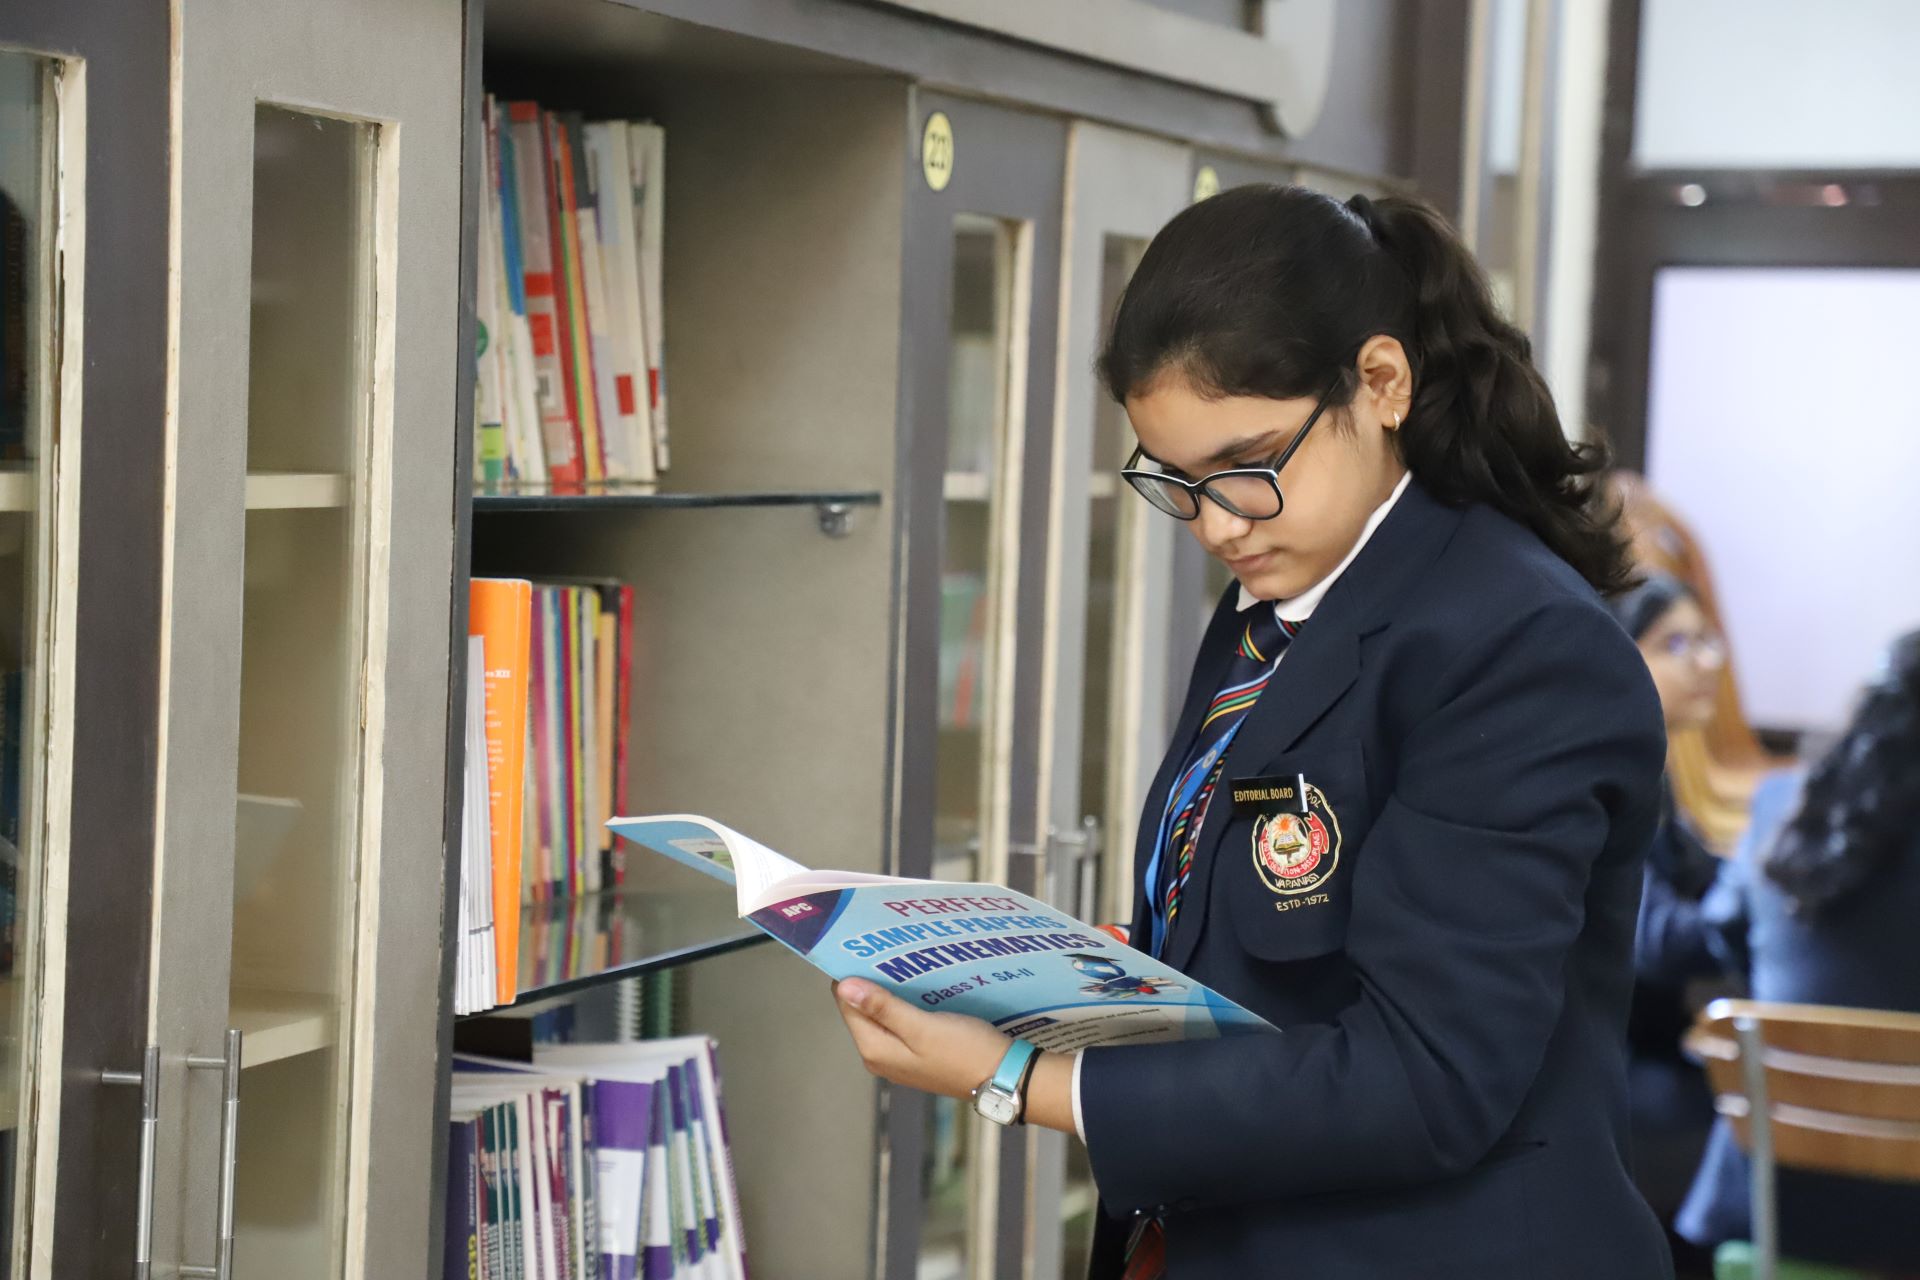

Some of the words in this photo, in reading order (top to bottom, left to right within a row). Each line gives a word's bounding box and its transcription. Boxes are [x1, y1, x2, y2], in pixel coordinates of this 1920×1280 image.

[1234, 789, 1269, 802] EDITORIAL
[1270, 787, 1293, 800] BOARD
[1275, 873, 1320, 889] VARANASI
[781, 901, 813, 918] APC
[883, 897, 1030, 917] PERFECT
[842, 918, 963, 958] SAMPLE
[950, 915, 1068, 933] PAPERS
[875, 933, 1106, 983] MATHEMATICS
[921, 982, 974, 1006] Class
[970, 975, 991, 987] X
[992, 968, 1035, 982] SA-II
